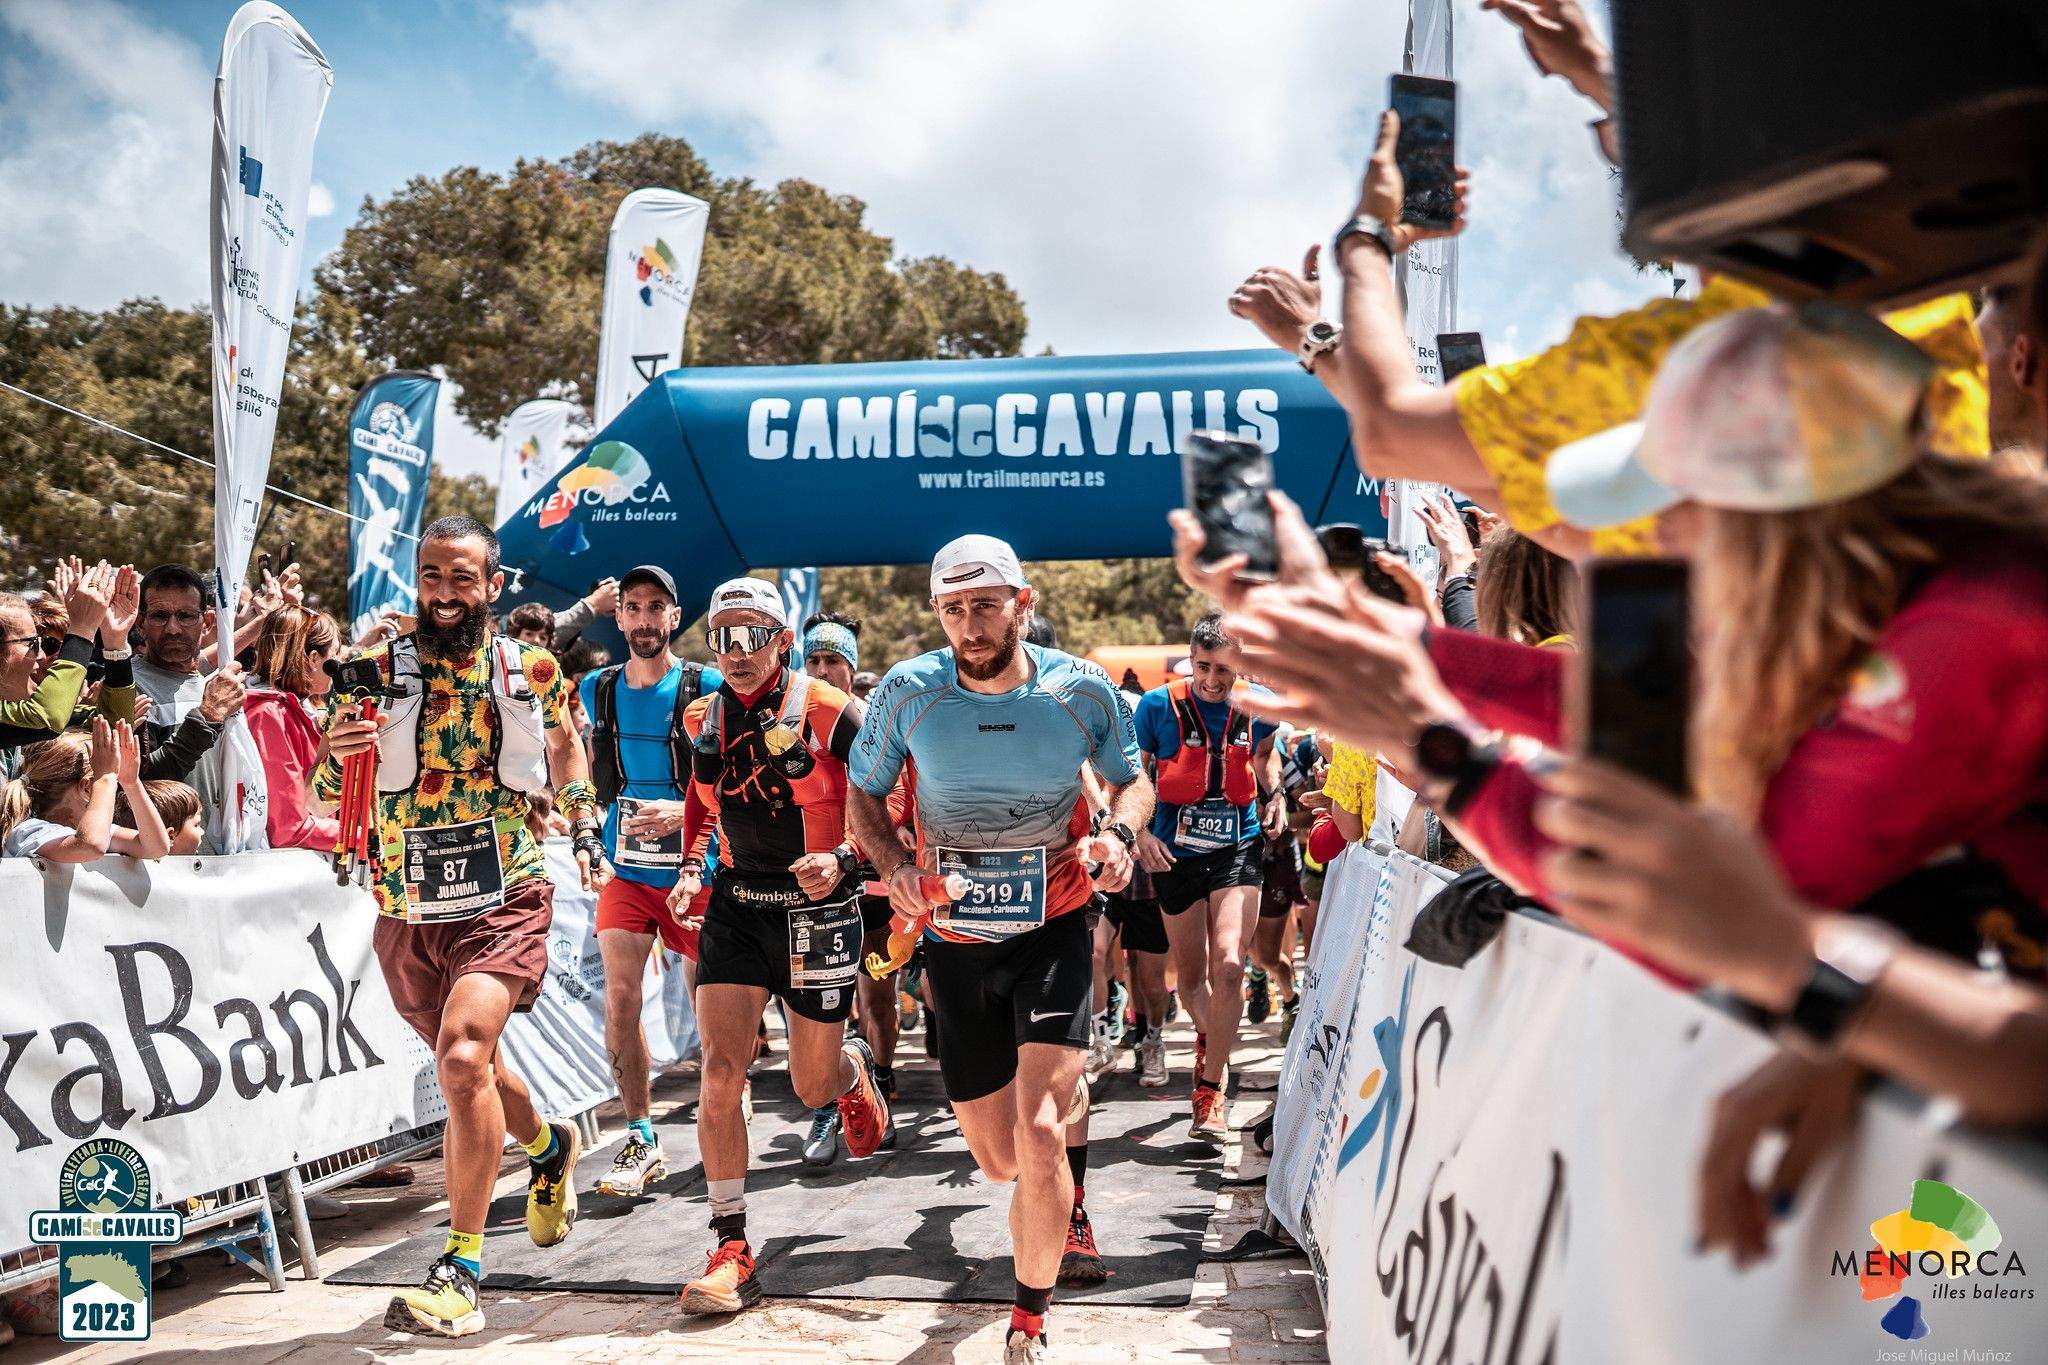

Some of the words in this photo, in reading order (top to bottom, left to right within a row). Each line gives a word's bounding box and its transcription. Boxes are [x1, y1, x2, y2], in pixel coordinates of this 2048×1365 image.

[919, 469, 1105, 489] www.trailmenorca.es
[524, 481, 671, 518] MENORCA
[592, 508, 619, 522] illes
[625, 507, 678, 522] balears
[1198, 818, 1222, 832] 502
[443, 858, 468, 882] 87
[980, 857, 1001, 866] 2023
[437, 881, 480, 899] JUANMA
[732, 885, 799, 902] Columbus
[972, 883, 1012, 904] 519
[1020, 881, 1033, 902] A
[833, 932, 844, 952] 5
[825, 954, 839, 965] Tolo
